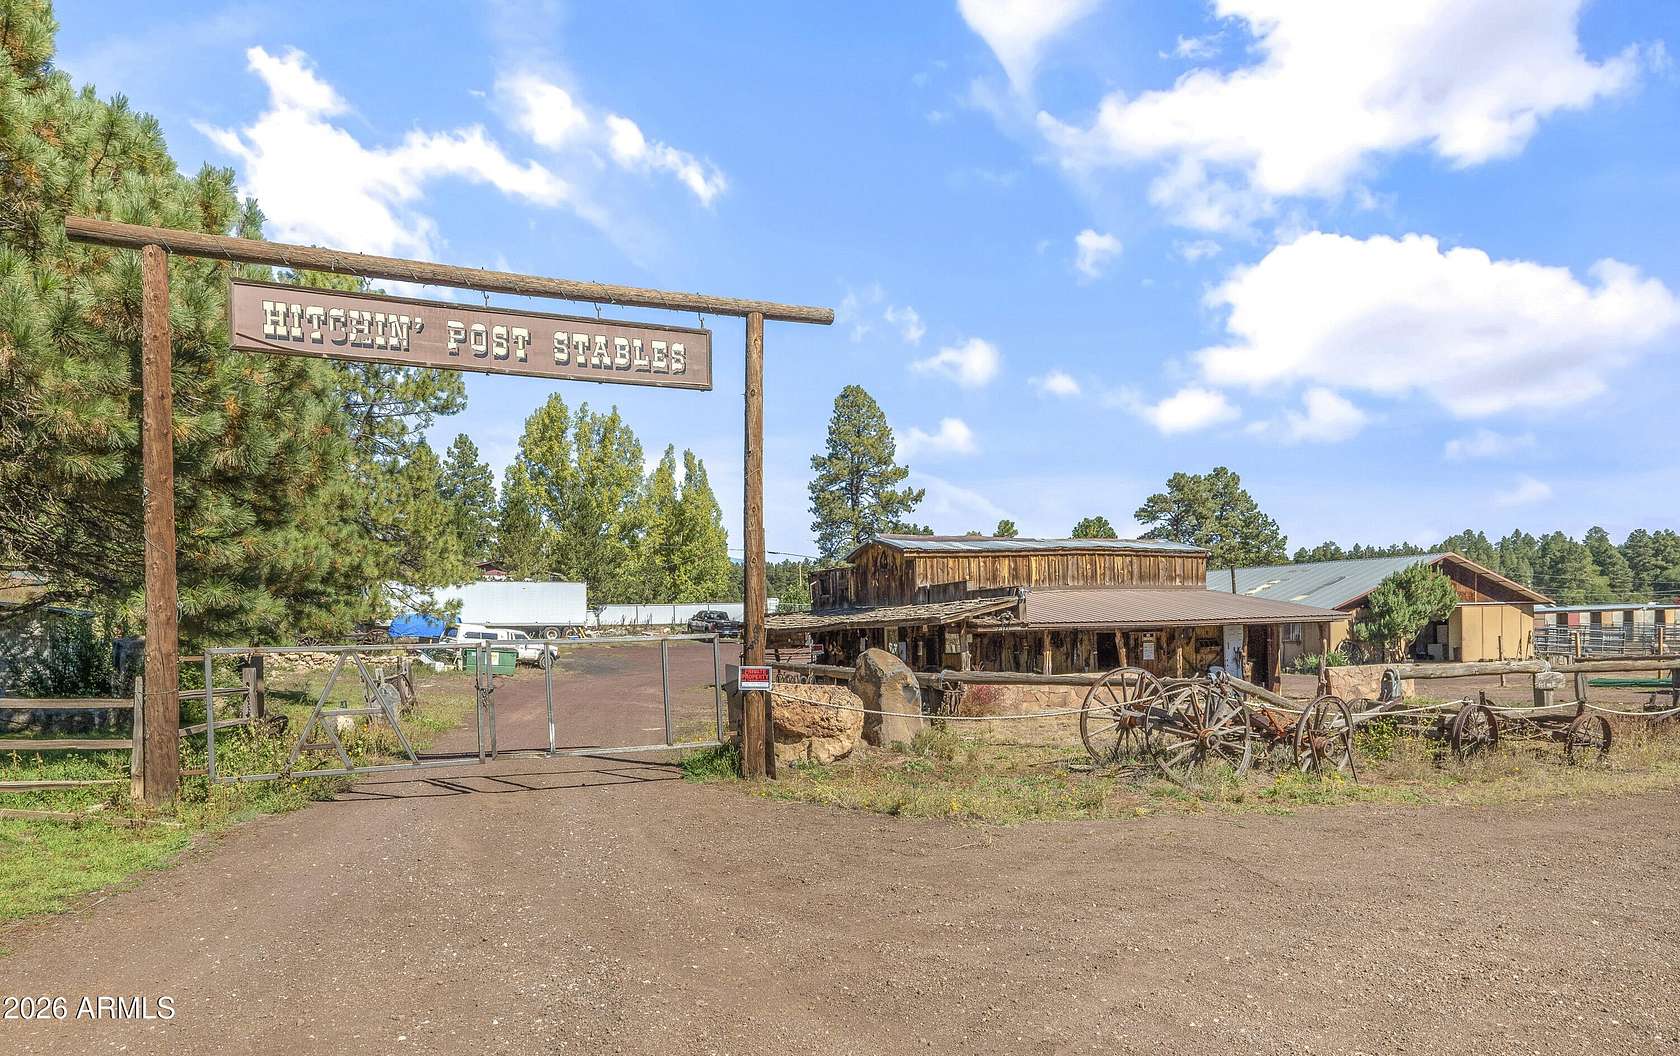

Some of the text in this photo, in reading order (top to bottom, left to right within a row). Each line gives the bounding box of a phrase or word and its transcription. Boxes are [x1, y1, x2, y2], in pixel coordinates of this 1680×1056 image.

[262, 300, 687, 375] HITCHIN' POST STABLES
